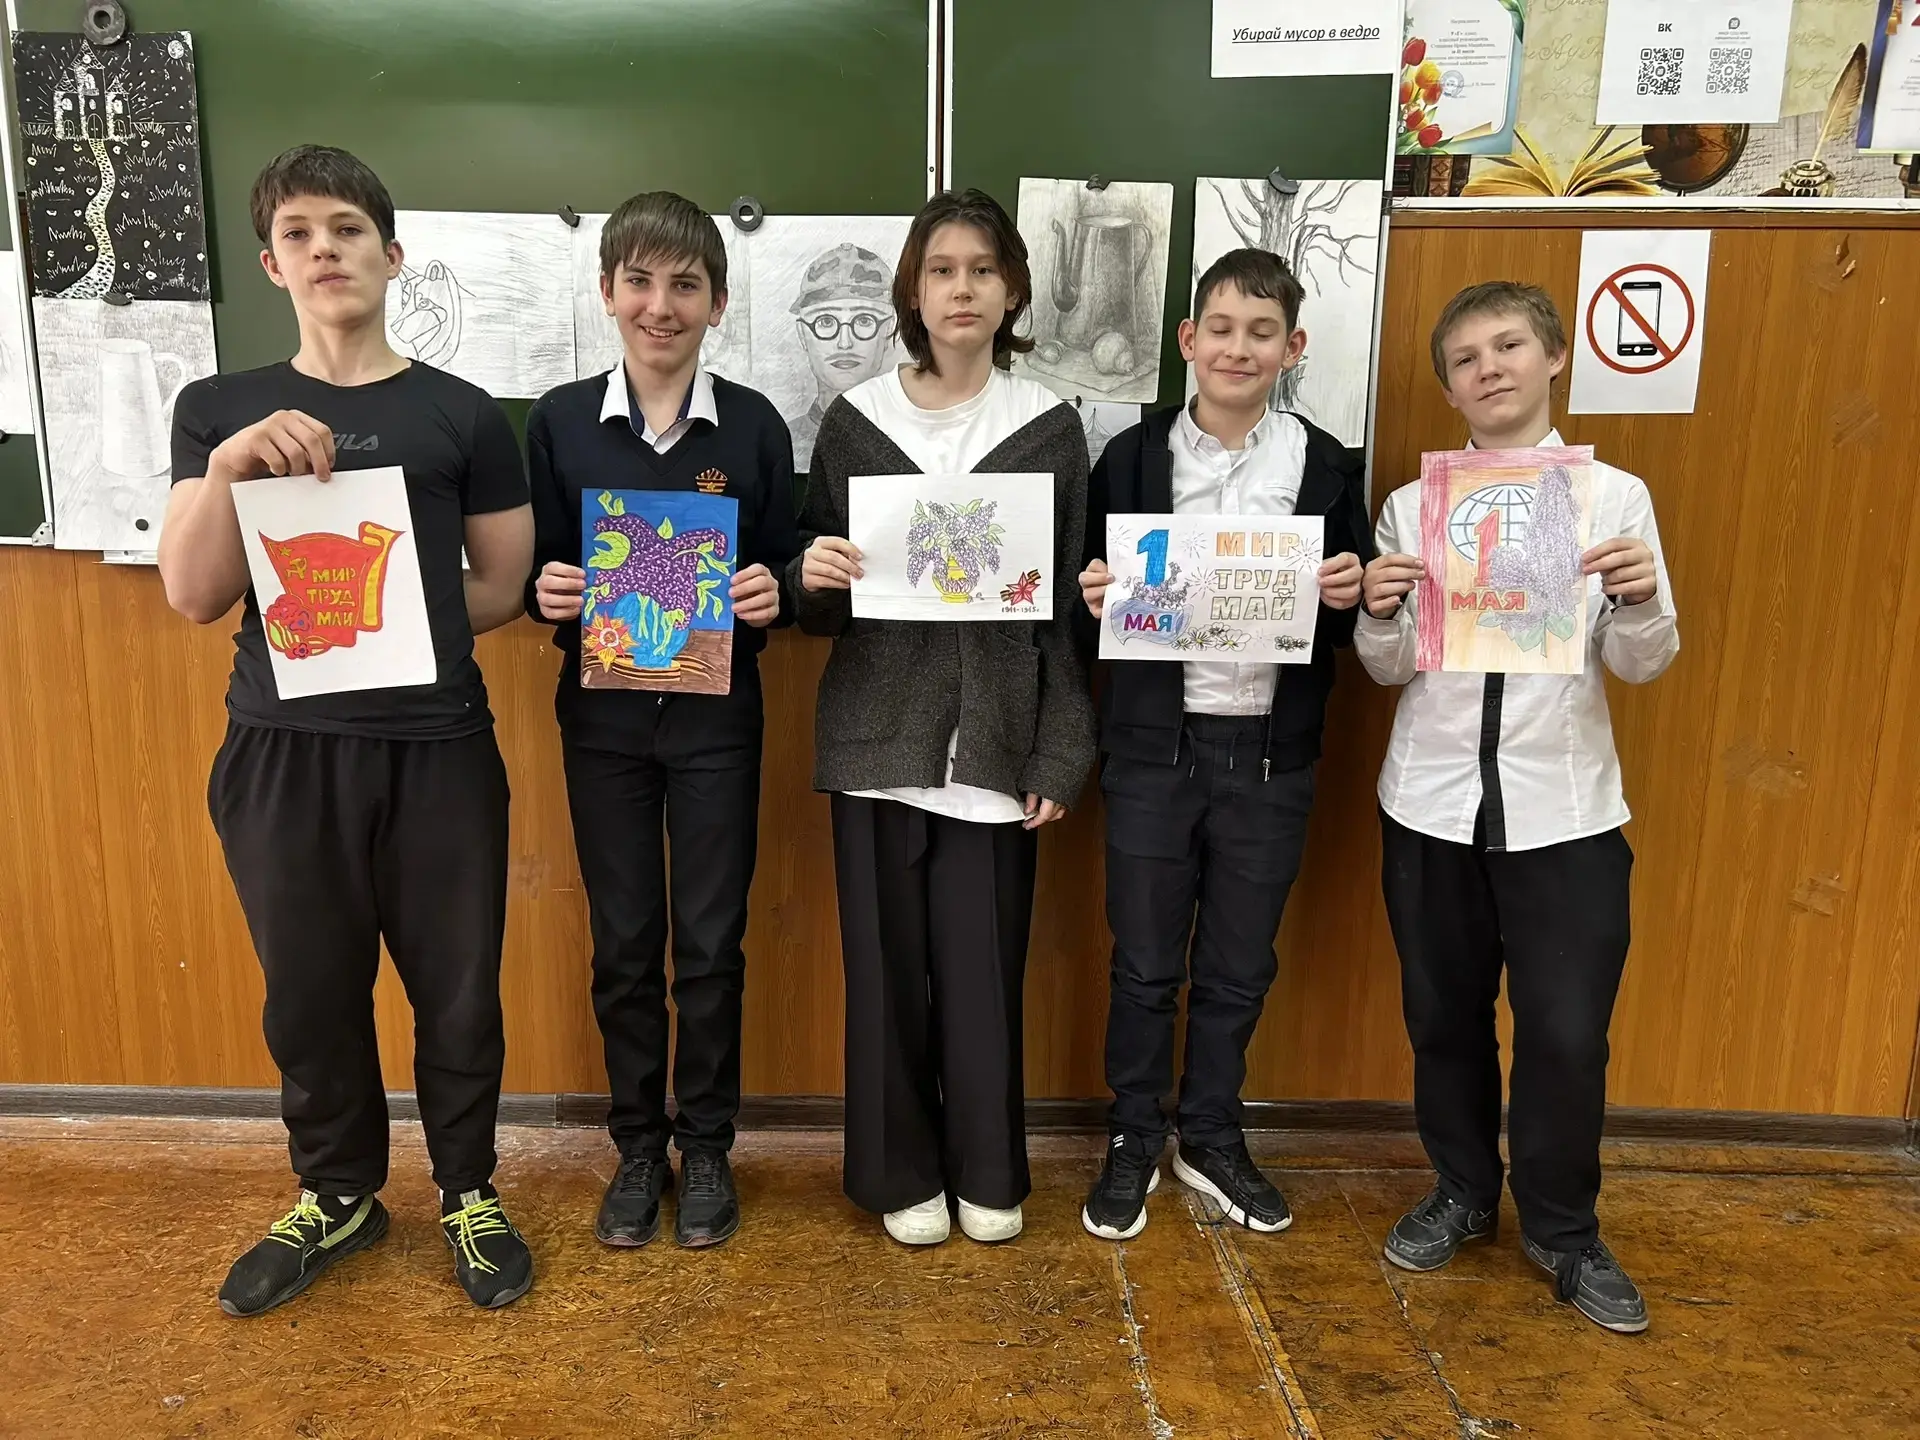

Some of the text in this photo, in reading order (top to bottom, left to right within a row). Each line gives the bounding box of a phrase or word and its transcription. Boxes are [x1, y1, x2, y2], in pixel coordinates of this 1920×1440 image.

[1232, 24, 1380, 42] Убирай мусор в ведро
[1215, 531, 1300, 557] МИР
[312, 567, 356, 583] МИР
[1215, 568, 1296, 593] ТРУД
[306, 588, 356, 607] ТРУД
[1210, 589, 1295, 621] МАЙ
[1450, 590, 1526, 611] МАЯ
[1123, 613, 1173, 633] МАЯ
